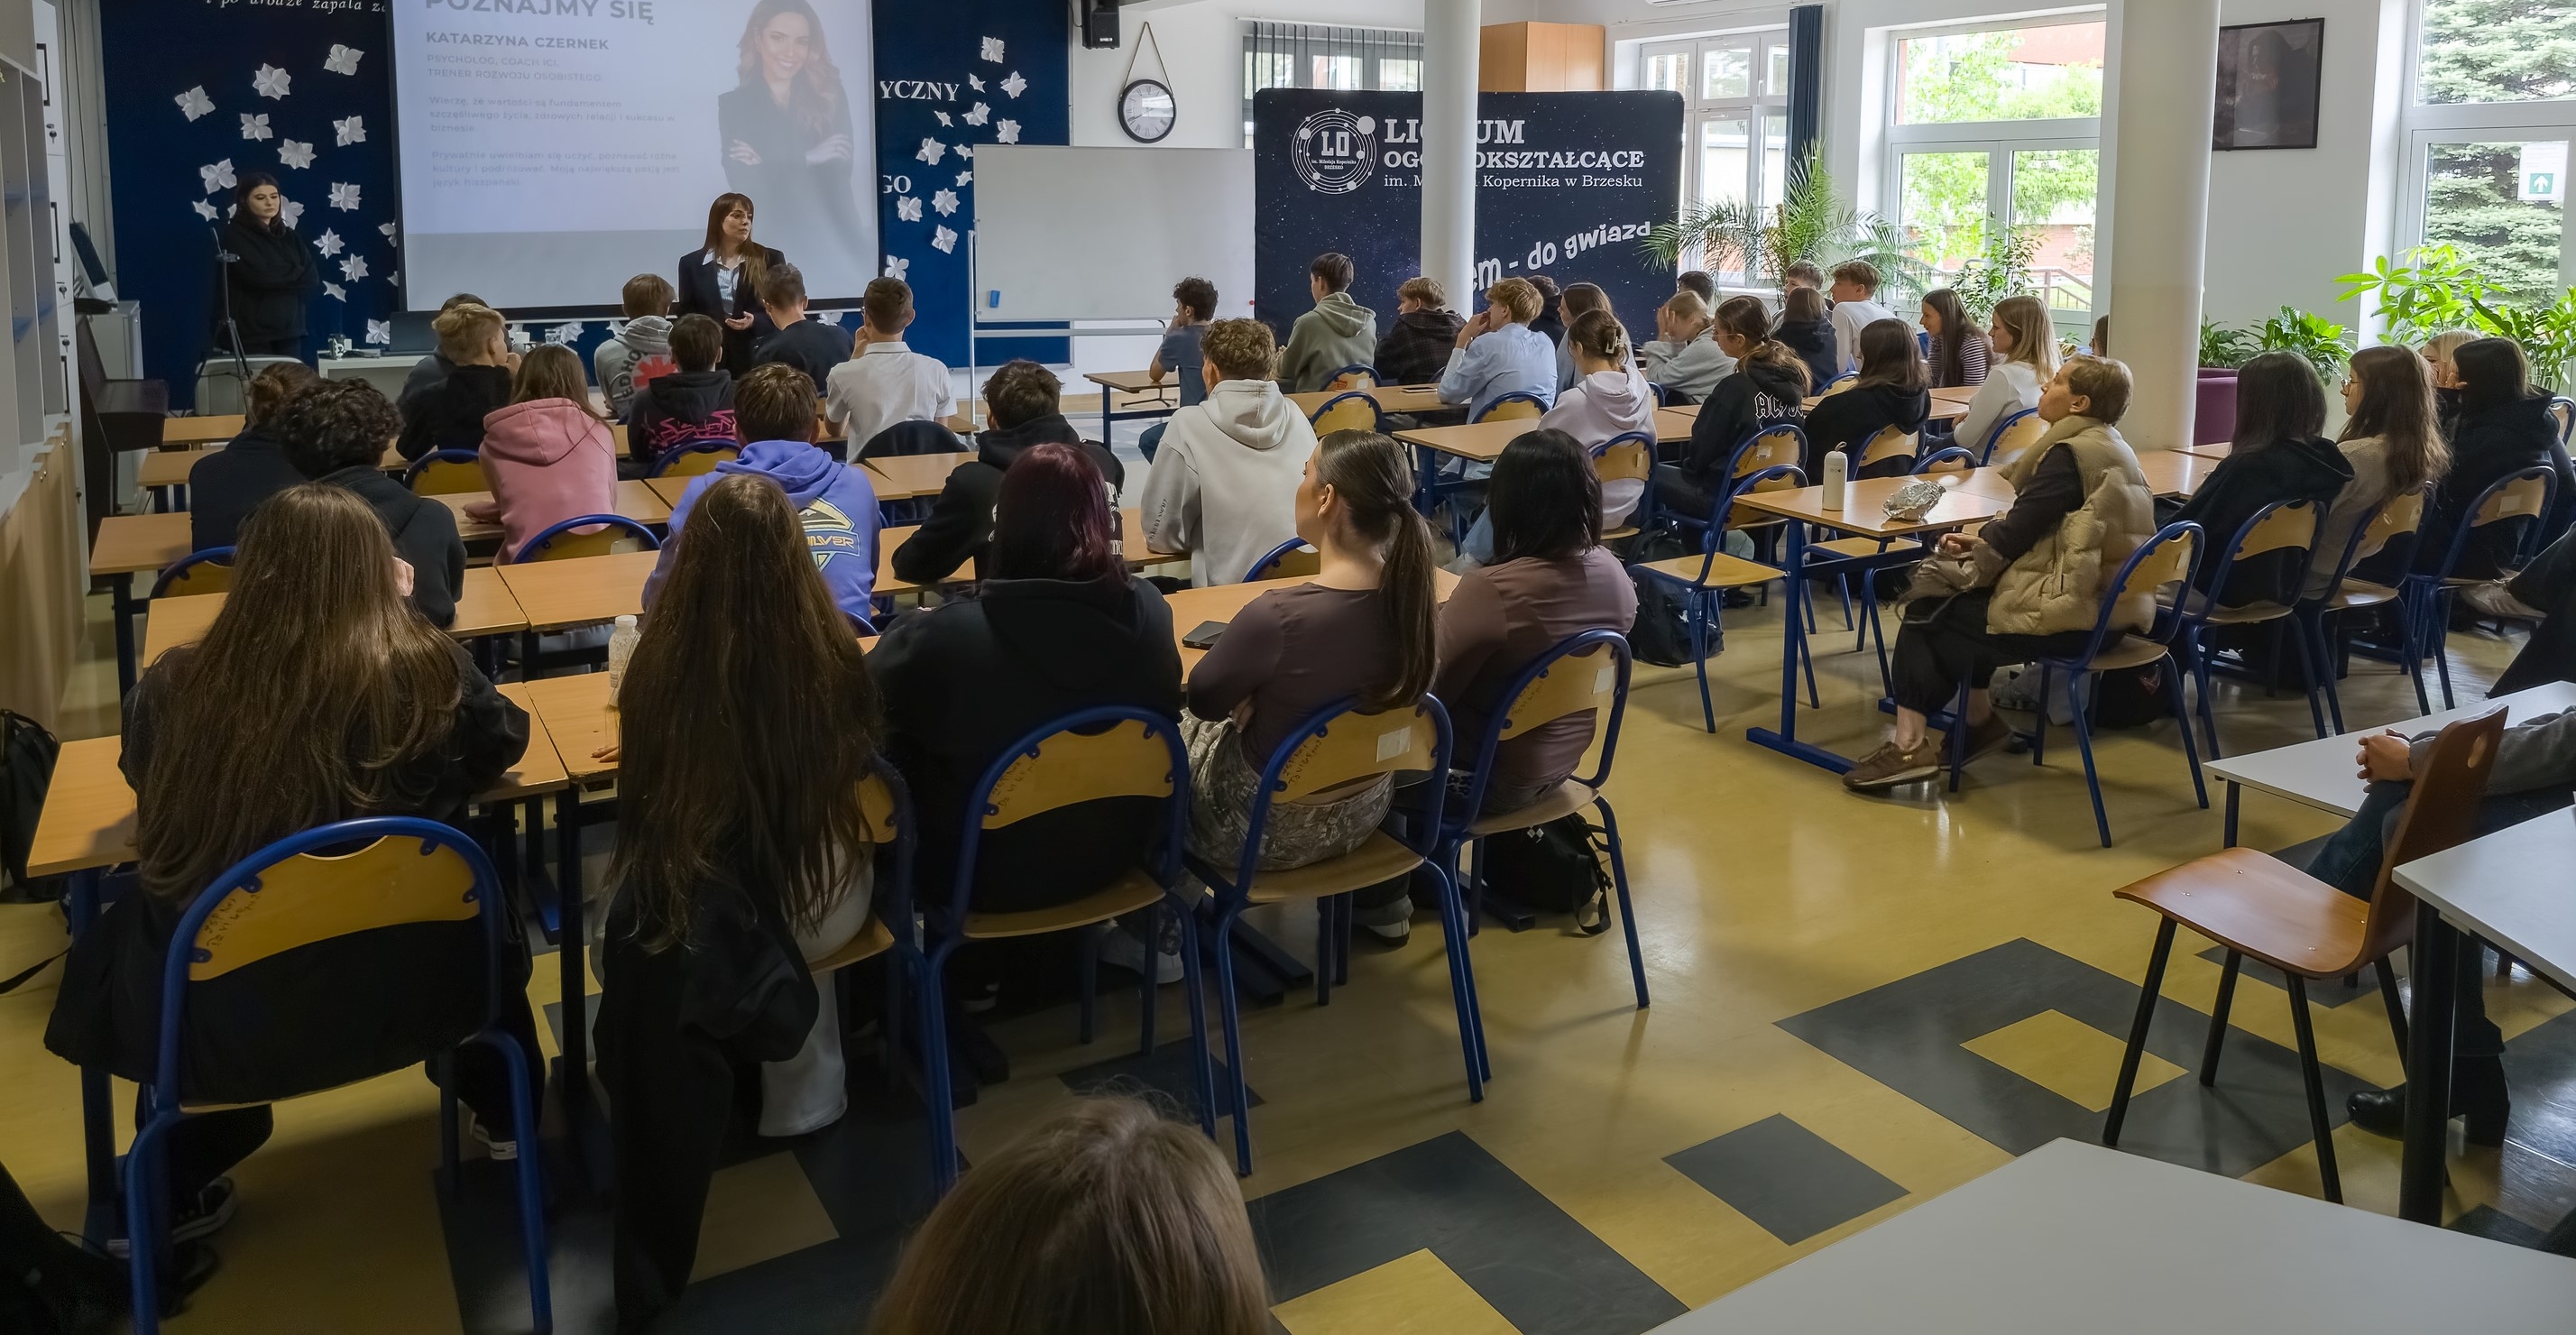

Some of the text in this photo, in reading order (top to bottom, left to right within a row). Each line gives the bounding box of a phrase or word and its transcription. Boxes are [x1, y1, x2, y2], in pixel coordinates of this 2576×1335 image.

[312, 0, 362, 14] zapala
[610, 0, 654, 25] SIĘ
[426, 31, 610, 50] KATARZYNA CZERNEK
[501, 57, 539, 67] COACH
[428, 68, 472, 78] TRENER
[475, 70, 530, 79] ROZWOJU
[879, 79, 960, 101] YCZNY
[1384, 118, 1526, 144] LIUM
[1321, 131, 1350, 157] LO
[1384, 174, 1407, 187] im.
[1483, 175, 1560, 189] Kopernika
[1565, 178, 1578, 187] w
[1582, 174, 1643, 187] Brzesku
[1527, 241, 1557, 270] do
[1564, 221, 1651, 260] gwiazd
